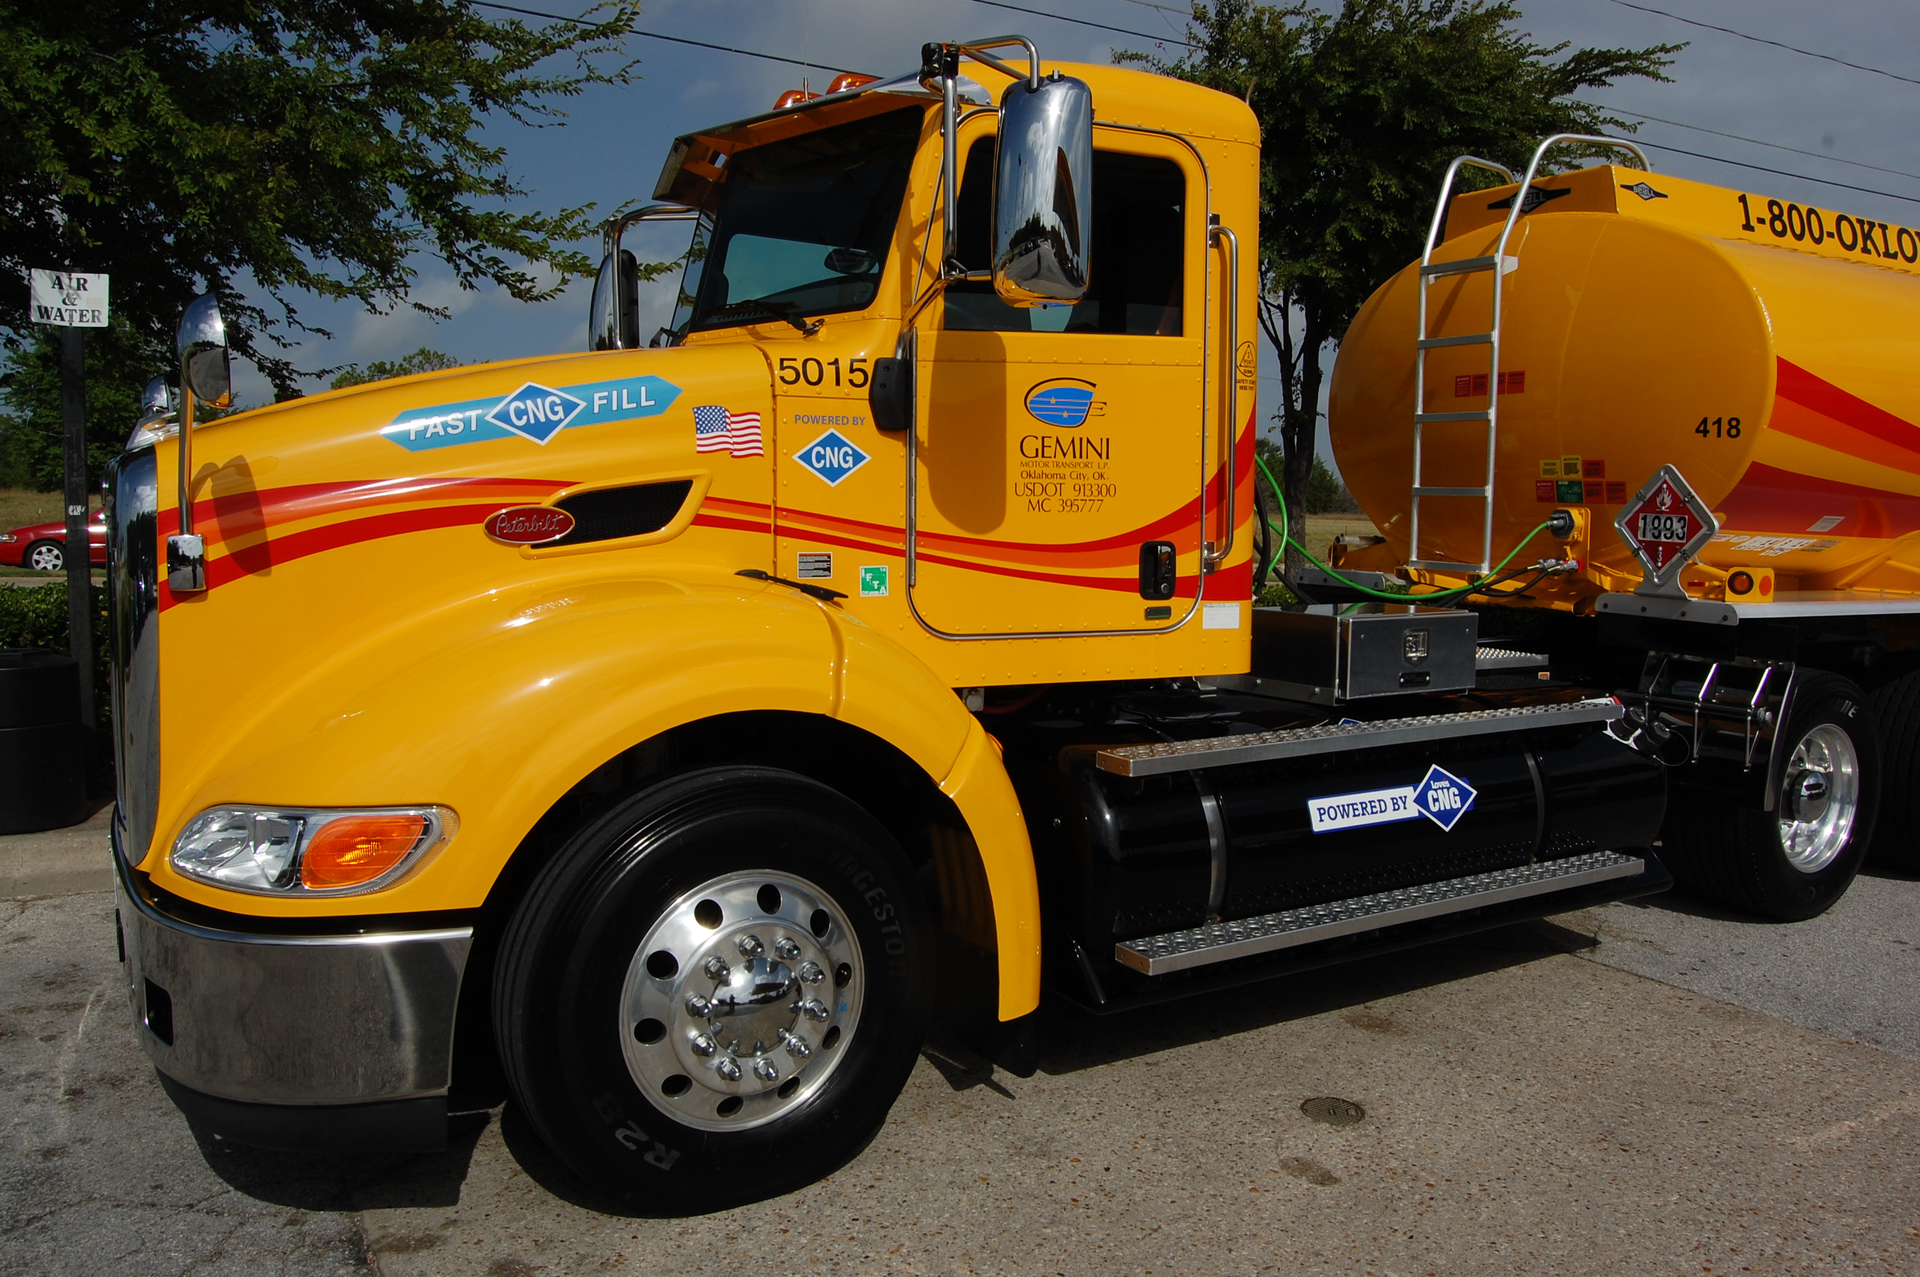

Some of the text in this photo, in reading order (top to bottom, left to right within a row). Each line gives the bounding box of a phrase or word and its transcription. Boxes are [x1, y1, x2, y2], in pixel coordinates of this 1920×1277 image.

[1738, 193, 1920, 264] 1-800-OKLO
[51, 275, 88, 291] AIR
[61, 292, 78, 306] &
[36, 305, 102, 323] WATER
[778, 357, 869, 388] 5015
[408, 385, 656, 441] FAST CNG FILL
[794, 414, 866, 426] POWERED BY
[1695, 416, 1741, 439] 418
[811, 446, 853, 469] CNG
[1019, 434, 1110, 460] GEMINI
[1020, 470, 1066, 480] Oklahoma
[1069, 471, 1089, 481] City,
[1051, 461, 1094, 469] TRANSPORT
[1014, 482, 1117, 497] USDOT 913300
[1027, 498, 1104, 513] MC 395777
[496, 514, 565, 536] Peterbilt
[1640, 514, 1686, 540] 1993
[1316, 795, 1408, 822] POWERED BY
[1427, 787, 1461, 813] CNG
